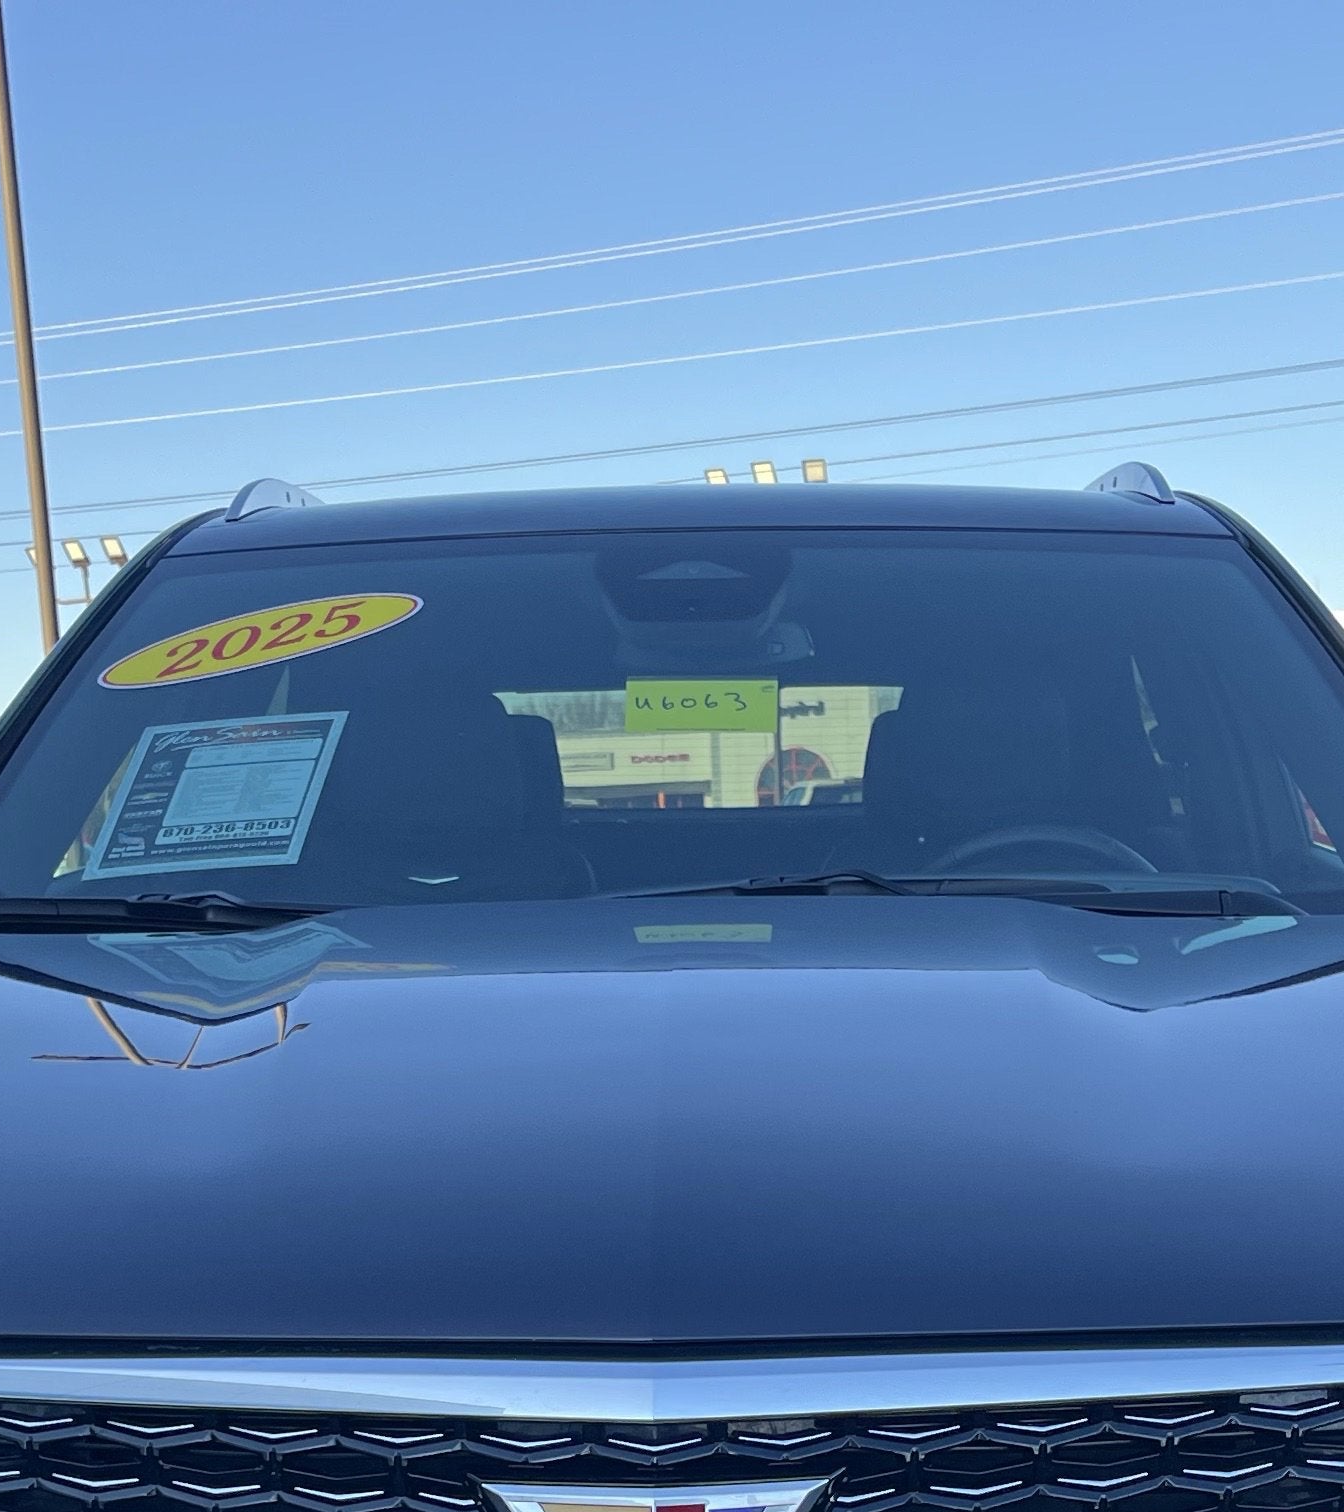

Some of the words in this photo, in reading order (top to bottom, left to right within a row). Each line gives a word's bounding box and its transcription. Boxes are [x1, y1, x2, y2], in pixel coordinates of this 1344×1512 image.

[157, 599, 365, 678] 2025
[630, 753, 691, 764] DODGE
[162, 818, 292, 838] 870-236-8503
